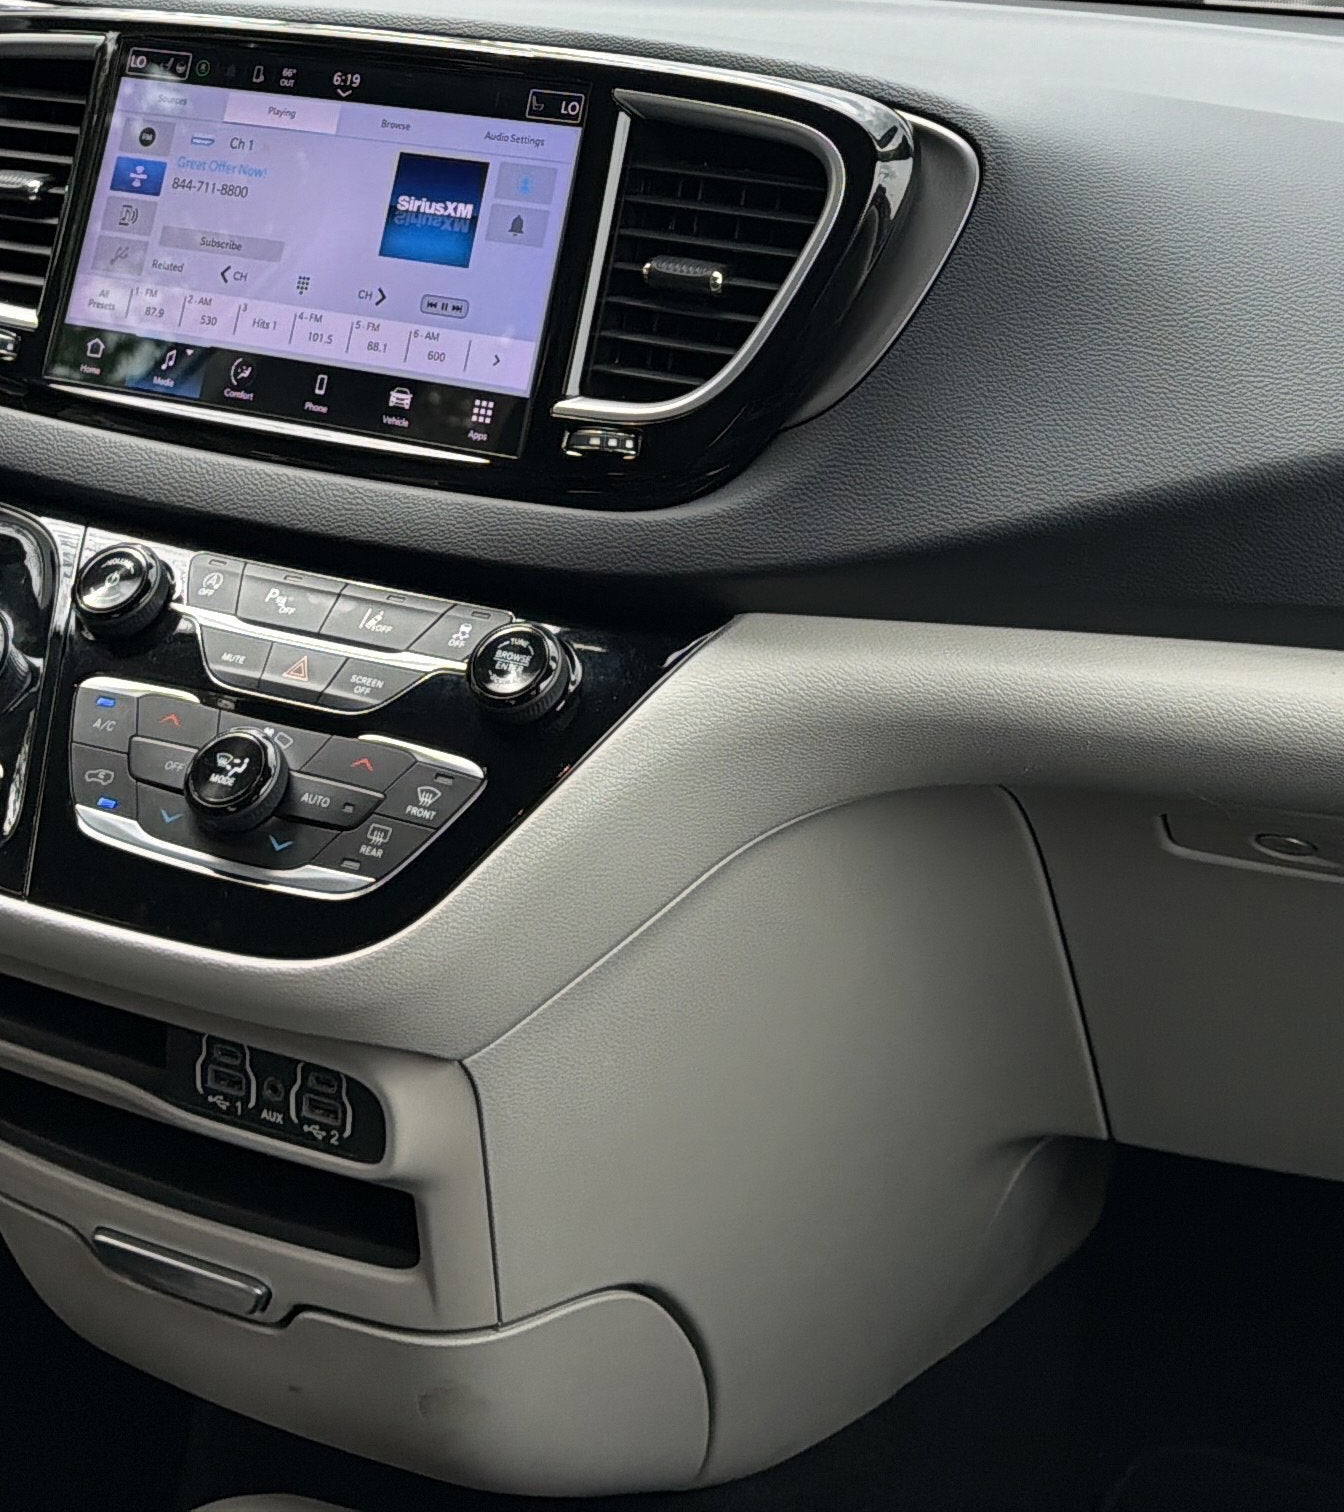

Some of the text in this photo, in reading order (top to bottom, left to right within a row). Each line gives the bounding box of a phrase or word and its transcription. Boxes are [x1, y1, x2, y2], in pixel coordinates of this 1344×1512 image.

[130, 55, 147, 68] LO
[279, 79, 295, 88] OUT
[332, 71, 361, 88] 6:19
[157, 94, 188, 106] Sources
[267, 106, 297, 120] Playing
[560, 100, 580, 116] LO
[381, 119, 411, 132] Browse
[229, 137, 245, 150] Ch
[248, 139, 254, 151] 1
[484, 131, 545, 149] Audio Settings
[177, 156, 268, 179] Great Offer Now!
[172, 177, 249, 199] 844-711-8800
[396, 194, 474, 219] SiriusXM
[200, 236, 243, 252] Subscribe
[152, 259, 185, 273] Related
[233, 271, 249, 282] CH
[358, 289, 373, 301] CH
[88, 299, 116, 312] Presets
[241, 302, 248, 313] 3
[145, 307, 165, 318] 87.9
[200, 315, 217, 326] 530
[252, 318, 271, 330] Hits
[308, 331, 334, 345] 101.5
[427, 350, 446, 362] 600
[80, 364, 101, 376] Home
[153, 375, 175, 388] Media
[224, 388, 254, 401] Comfort
[304, 401, 328, 414] Phone
[382, 414, 410, 428] Vehicle
[467, 430, 488, 442] Apps
[197, 588, 215, 597] OFF
[279, 606, 296, 616] OFF
[448, 638, 465, 648] OFF
[221, 652, 247, 664] MUTE
[495, 649, 532, 664] BROWSE
[350, 674, 385, 689] SCREEN
[353, 685, 372, 696] OFF
[93, 718, 117, 732] A/C
[164, 760, 186, 772] OFF
[209, 775, 236, 787] MODE
[300, 791, 331, 808] AUTO
[405, 804, 436, 821] FRONT
[359, 844, 384, 859] REAR
[235, 1100, 242, 1116] 1
[260, 1108, 284, 1125] AUX
[330, 1130, 340, 1147] 2
